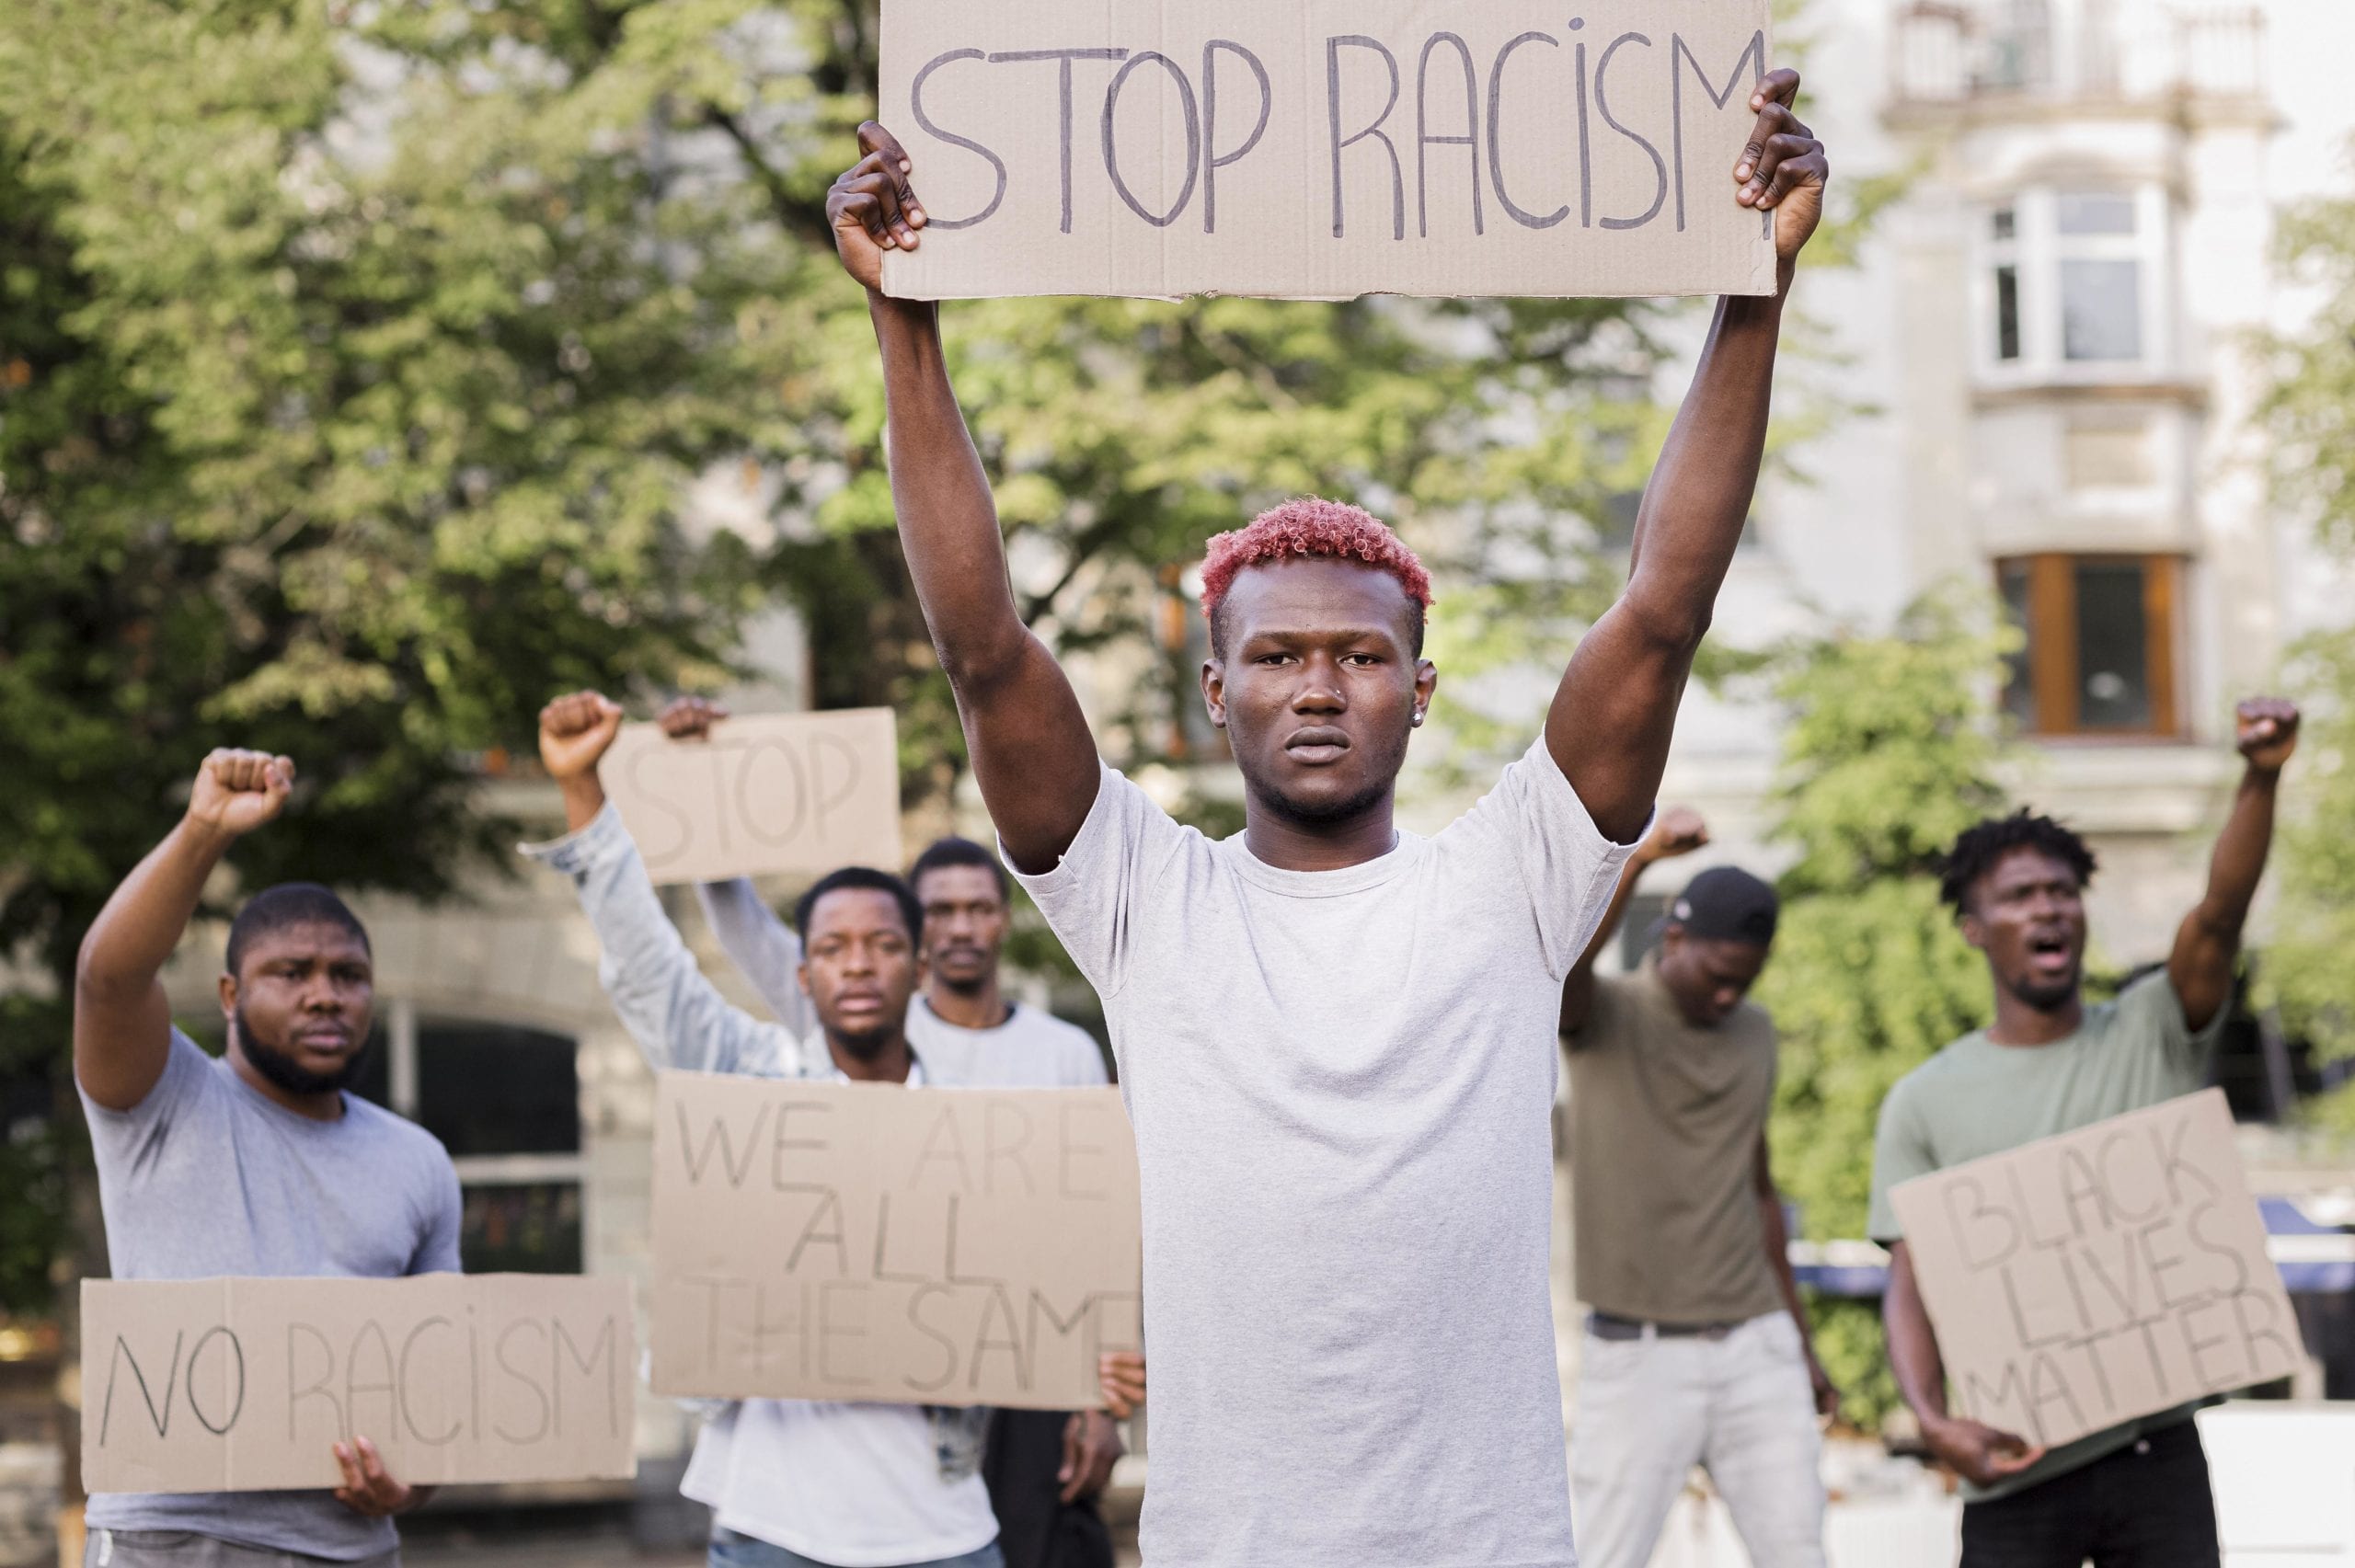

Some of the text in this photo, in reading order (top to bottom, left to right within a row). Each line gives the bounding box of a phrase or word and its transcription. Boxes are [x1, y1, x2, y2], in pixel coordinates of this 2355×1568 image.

[911, 39, 1271, 234] STOP
[625, 734, 861, 867] STOP
[675, 1100, 1107, 1201] WE ARE
[1943, 1119, 2223, 1274] BLACK
[785, 1192, 1010, 1288] ALL
[2001, 1201, 2250, 1350] LIVES
[99, 1325, 244, 1447] NO
[676, 1275, 875, 1389] THE
[1962, 1288, 2299, 1448] MATTER
